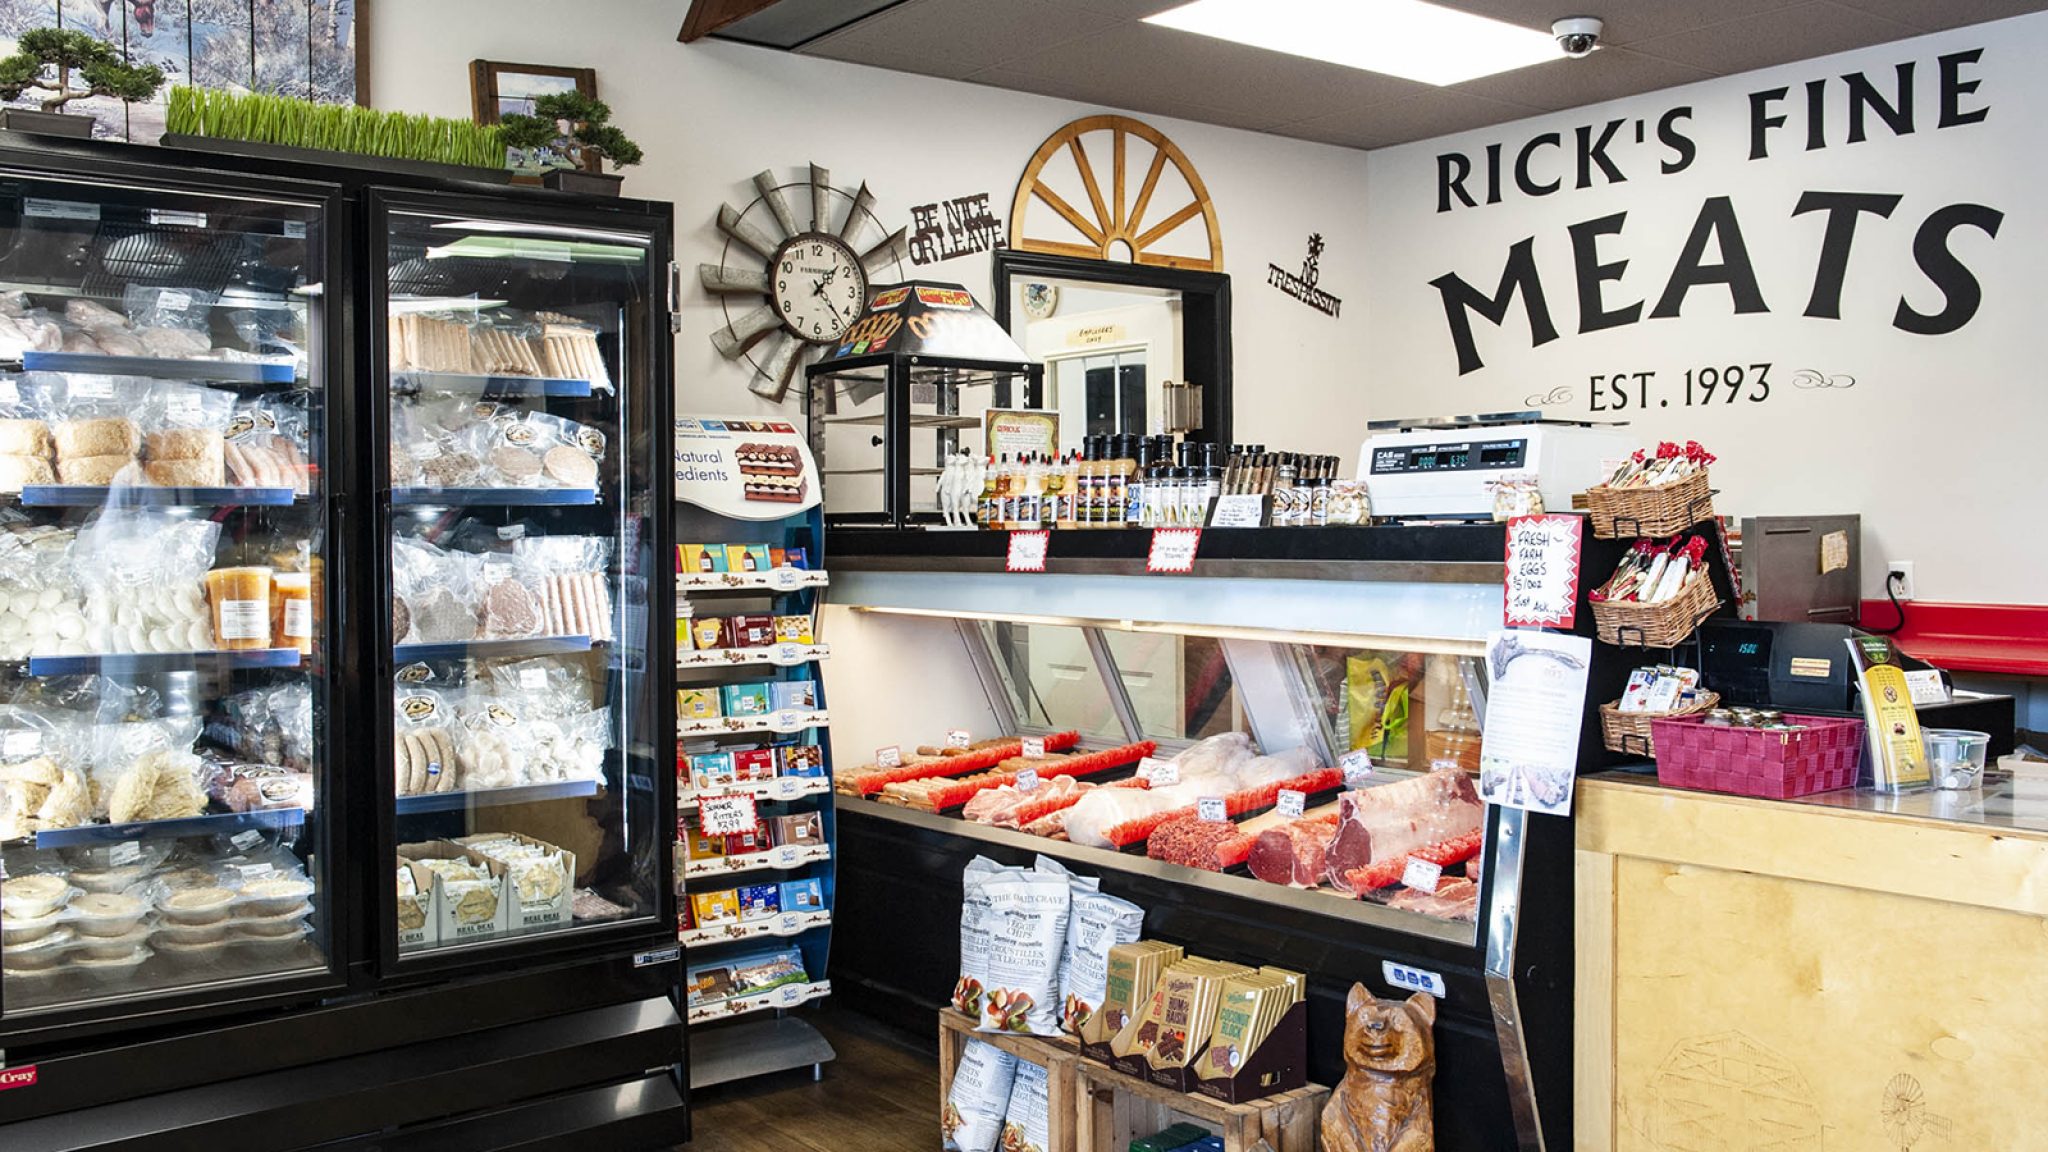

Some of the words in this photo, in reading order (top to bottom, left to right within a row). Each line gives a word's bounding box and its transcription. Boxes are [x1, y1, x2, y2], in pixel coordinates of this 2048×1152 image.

[1436, 106, 1697, 213] RICK'S
[1748, 48, 1991, 161] FINE
[910, 203, 943, 237] BE
[942, 192, 993, 236] NICE
[909, 233, 938, 266] OR
[938, 219, 1007, 261] LEAVE
[796, 249, 804, 260] 11
[812, 245, 823, 257] 12
[832, 252, 837, 263] 1
[782, 261, 793, 274] 10
[843, 266, 851, 278] 2
[1302, 260, 1319, 287] NO
[779, 281, 787, 293] 9
[1428, 191, 2005, 376] MEATS
[848, 287, 856, 299] 3
[784, 300, 791, 313] 8
[843, 306, 850, 316] 4
[797, 316, 804, 328] 7
[814, 322, 822, 334] 6
[831, 319, 839, 330] 5
[1590, 371, 1668, 412] EST.
[1684, 364, 1773, 407] 1993
[675, 465, 728, 481] edients
[1518, 531, 1550, 547] FRESH
[1519, 548, 1543, 560] FARM
[1520, 562, 1547, 576] EGGS
[1006, 928, 1033, 939] CHIPS
[0, 1071, 35, 1084] Cray
